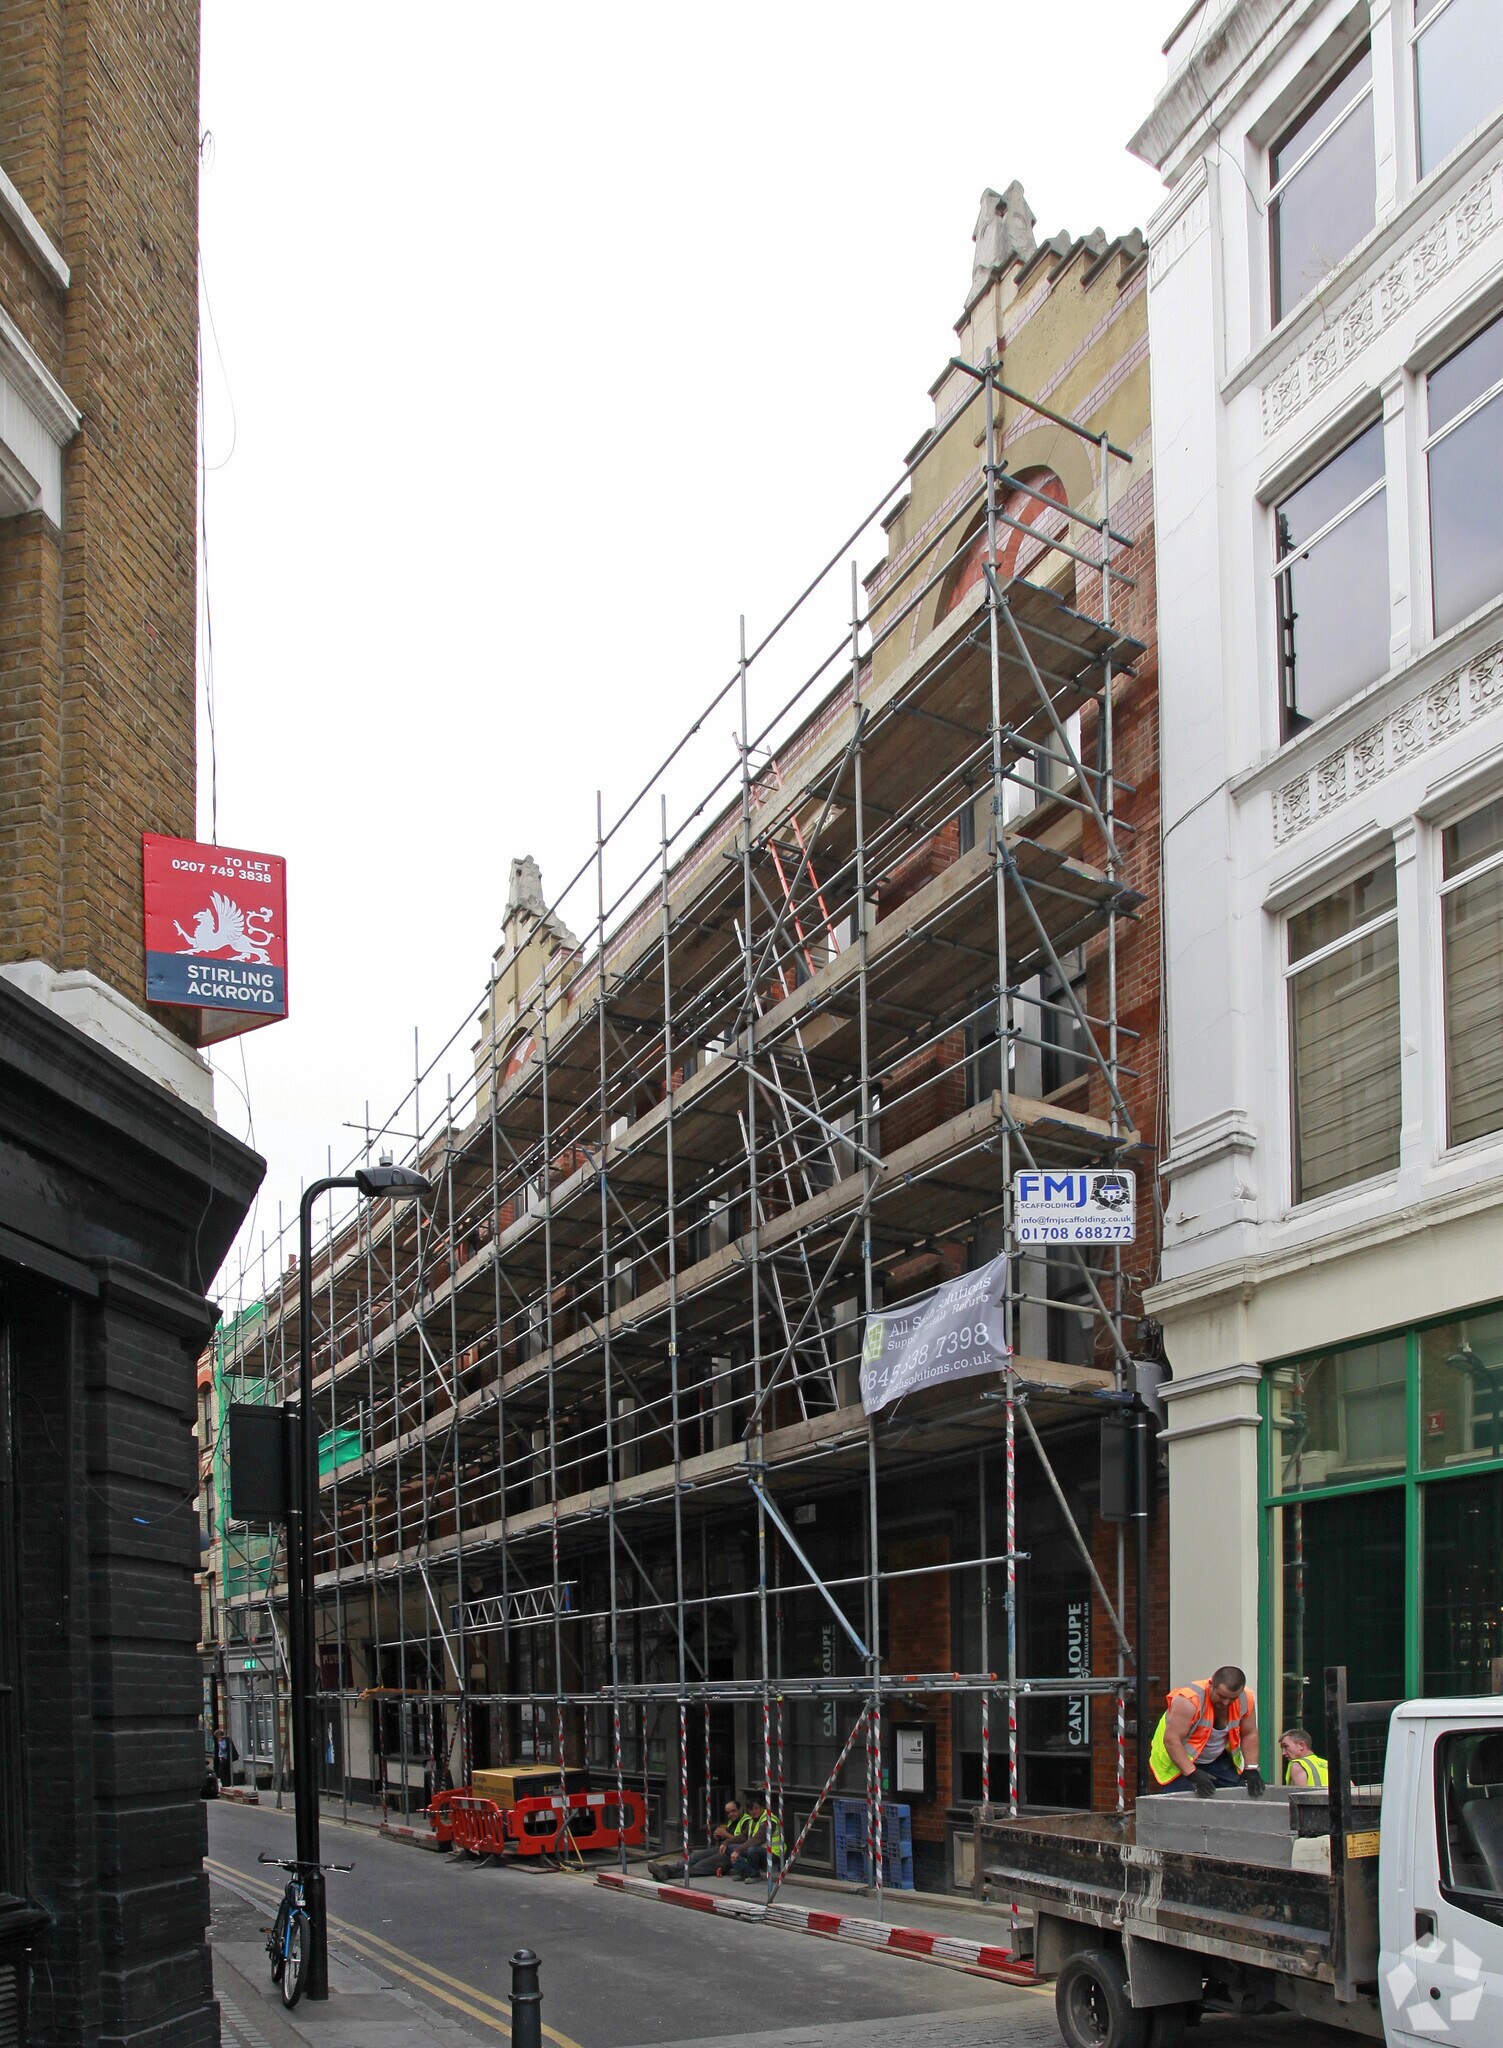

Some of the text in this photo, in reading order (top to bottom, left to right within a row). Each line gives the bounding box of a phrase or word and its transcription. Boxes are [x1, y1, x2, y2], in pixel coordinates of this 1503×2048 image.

[171, 859, 272, 883] 0207 749 3838
[224, 856, 270, 872] TO LET
[187, 964, 274, 988] STIRLING
[187, 981, 275, 1004] ACKROYD
[1020, 1175, 1087, 1208] FMJ
[1020, 1215, 1132, 1226] info@fmjscaffolding.co.uk
[1021, 1226, 1132, 1240] 01708 688272
[951, 1292, 989, 1315] Refurb
[889, 1319, 909, 1338] All
[861, 1362, 901, 1394] 0845
[935, 1322, 990, 1359] 7398
[1068, 1603, 1082, 1746] CANLOUPE
